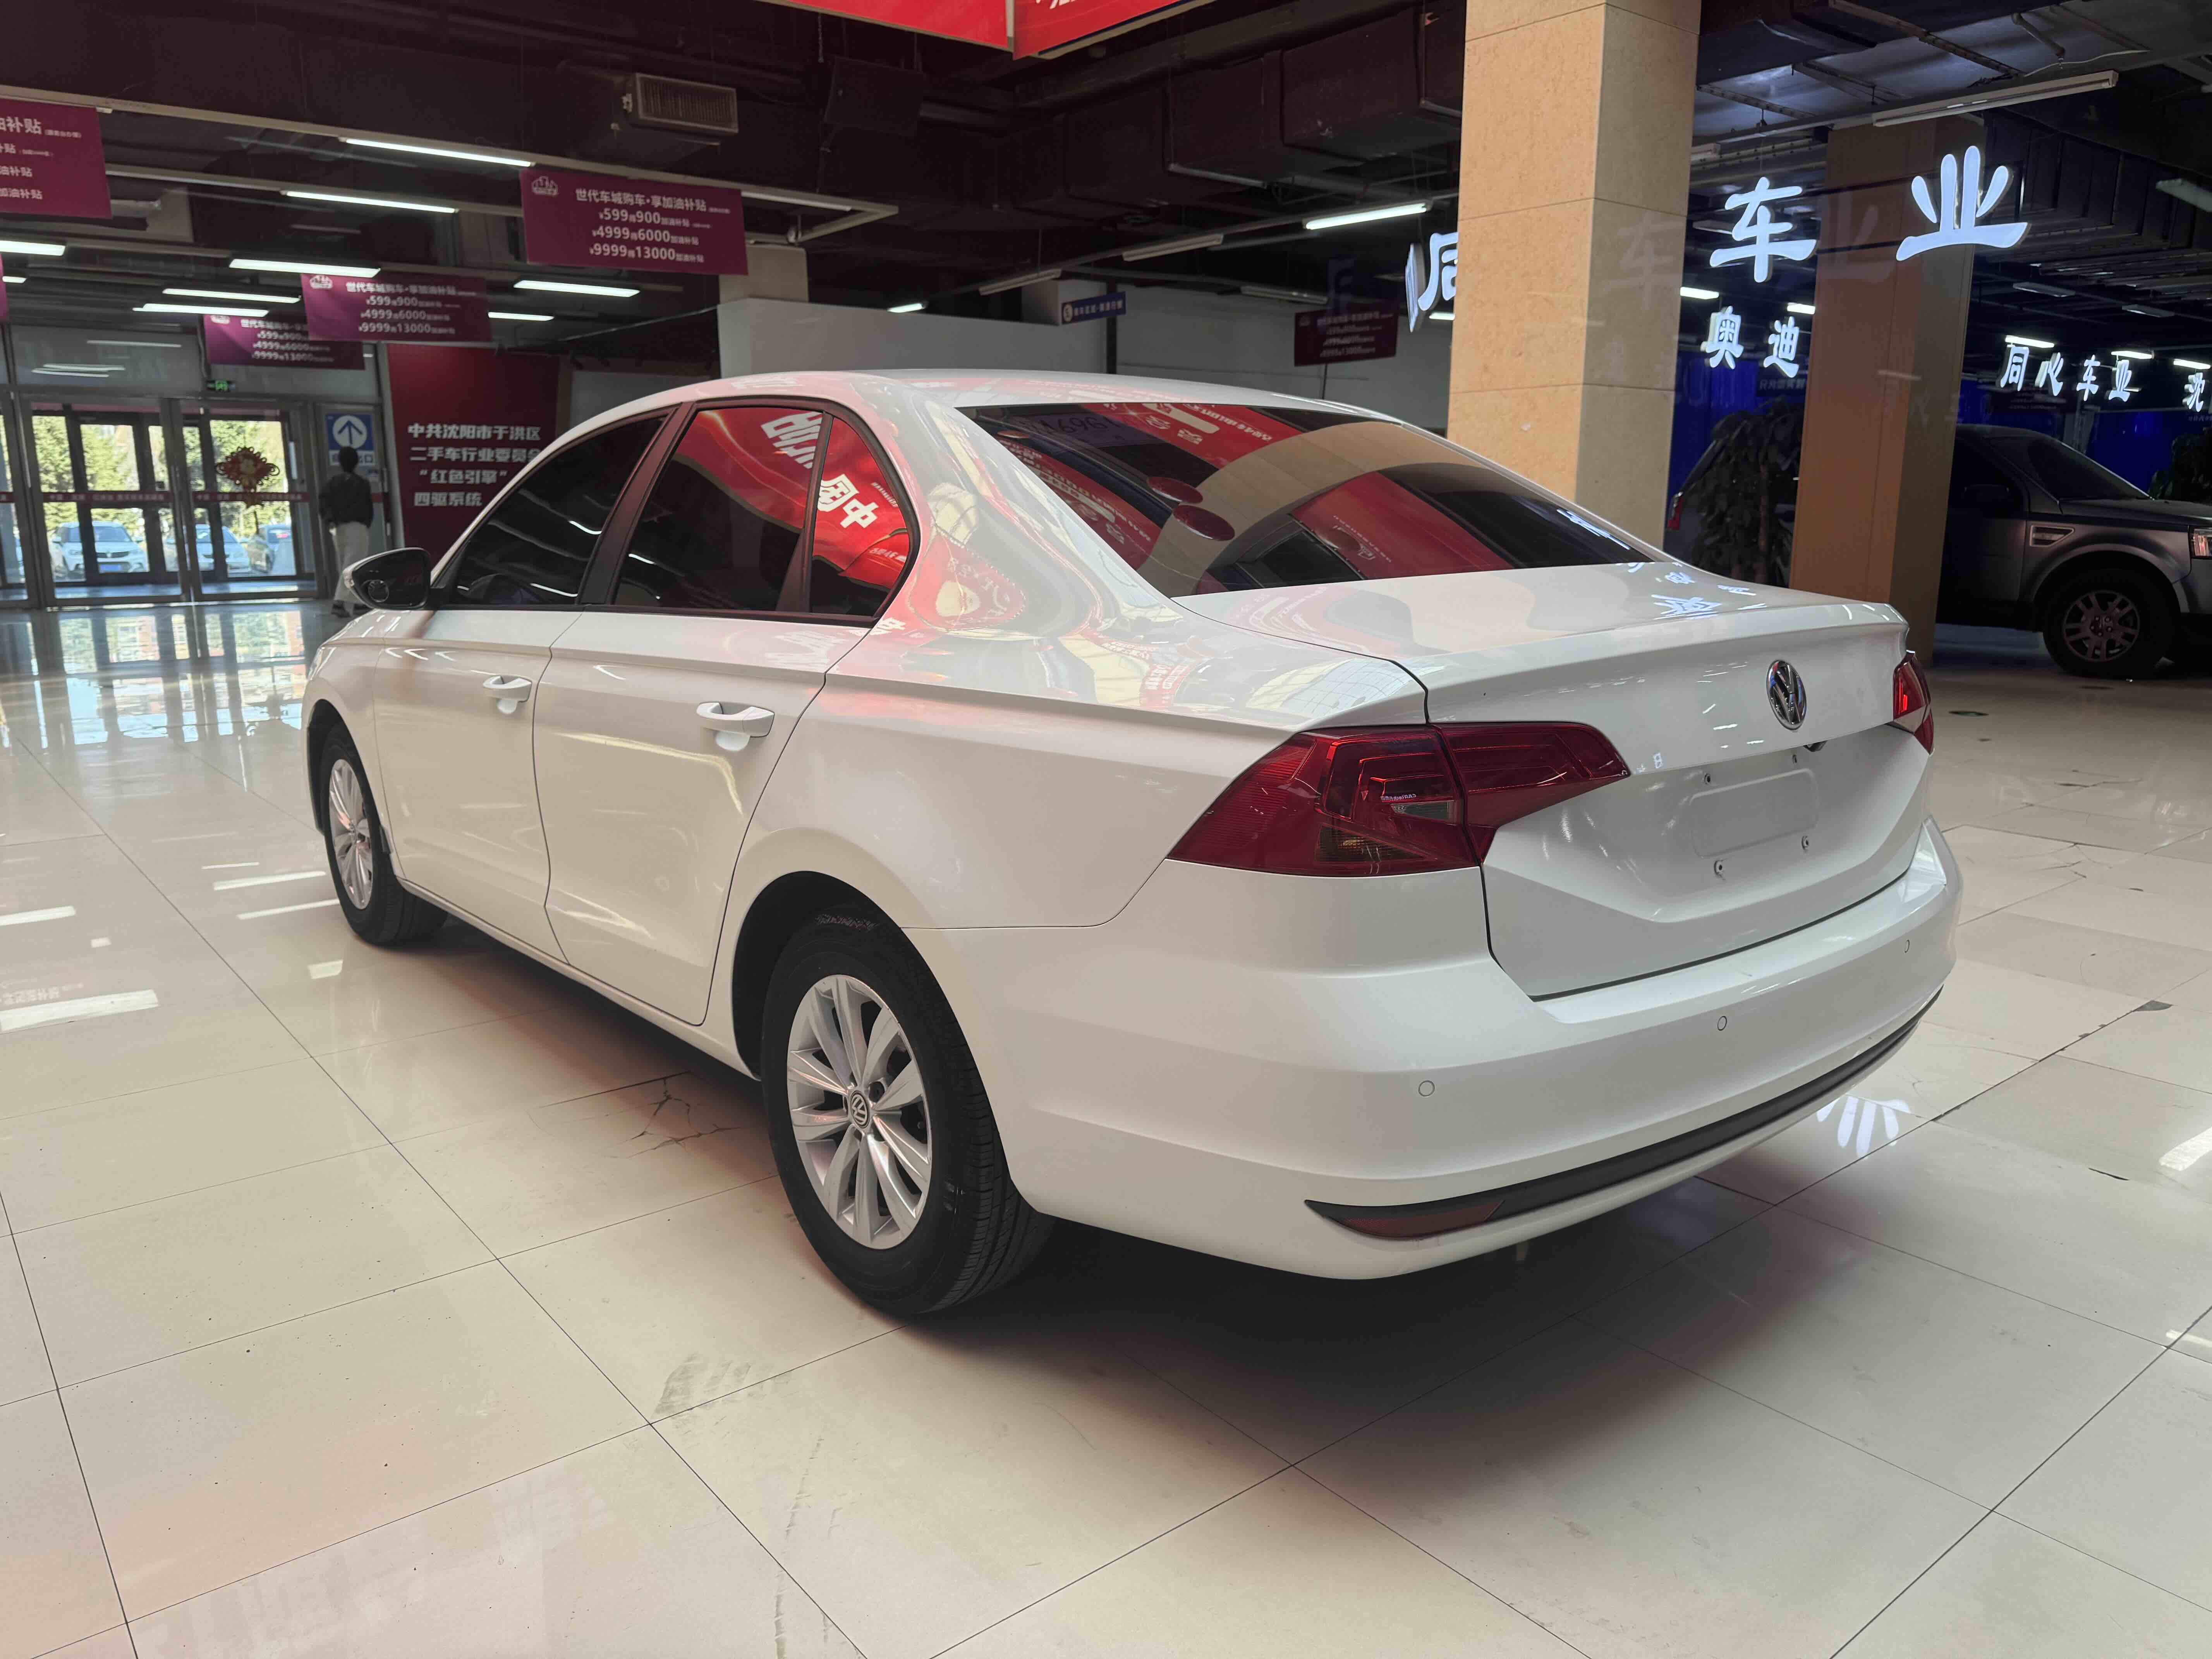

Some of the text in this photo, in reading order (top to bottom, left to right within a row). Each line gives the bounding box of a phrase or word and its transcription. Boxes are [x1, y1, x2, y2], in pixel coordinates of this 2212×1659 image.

[1705, 306, 1799, 378] 奥迪
[408, 422, 541, 440] 中共沈阳市于洪区
[414, 491, 483, 507] 四驱系统
